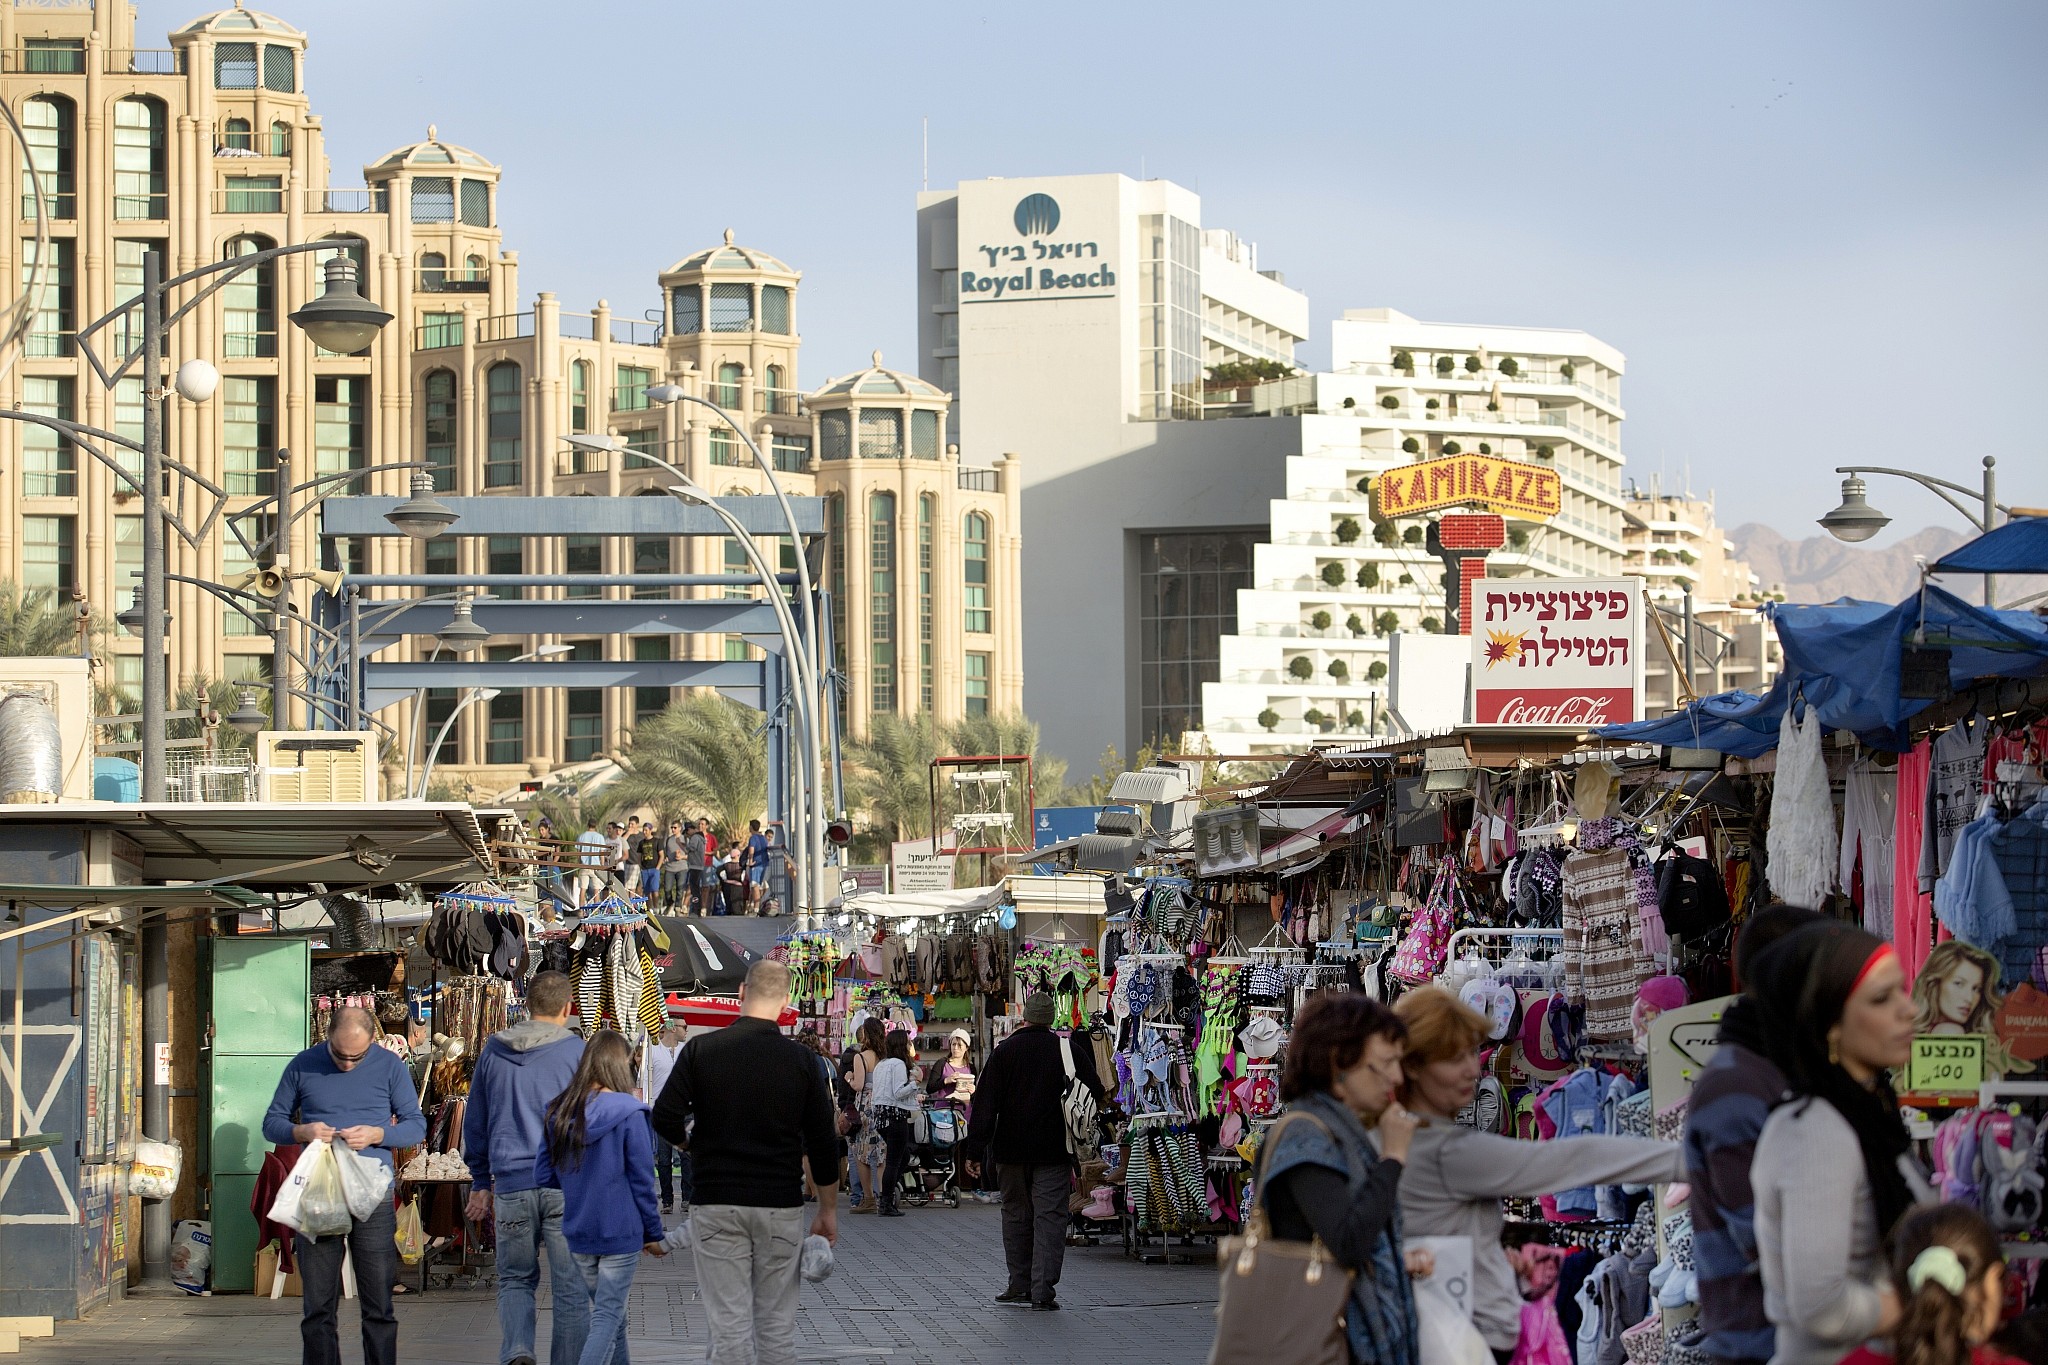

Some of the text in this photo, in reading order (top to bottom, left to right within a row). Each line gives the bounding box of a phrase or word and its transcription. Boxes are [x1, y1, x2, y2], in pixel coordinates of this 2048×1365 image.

[1033, 240, 1098, 259] רויאל
[961, 263, 1116, 298] Royal Beach
[1383, 460, 1556, 510] KAMIKAZE
[1485, 590, 1629, 622] פיצוציית
[1518, 626, 1629, 667] הטיילת
[1496, 696, 1614, 724] Coca-Cola
[908, 853, 939, 863] דיעתך!
[1920, 1045, 1975, 1058] מבצע
[1933, 1065, 1963, 1079] 100
